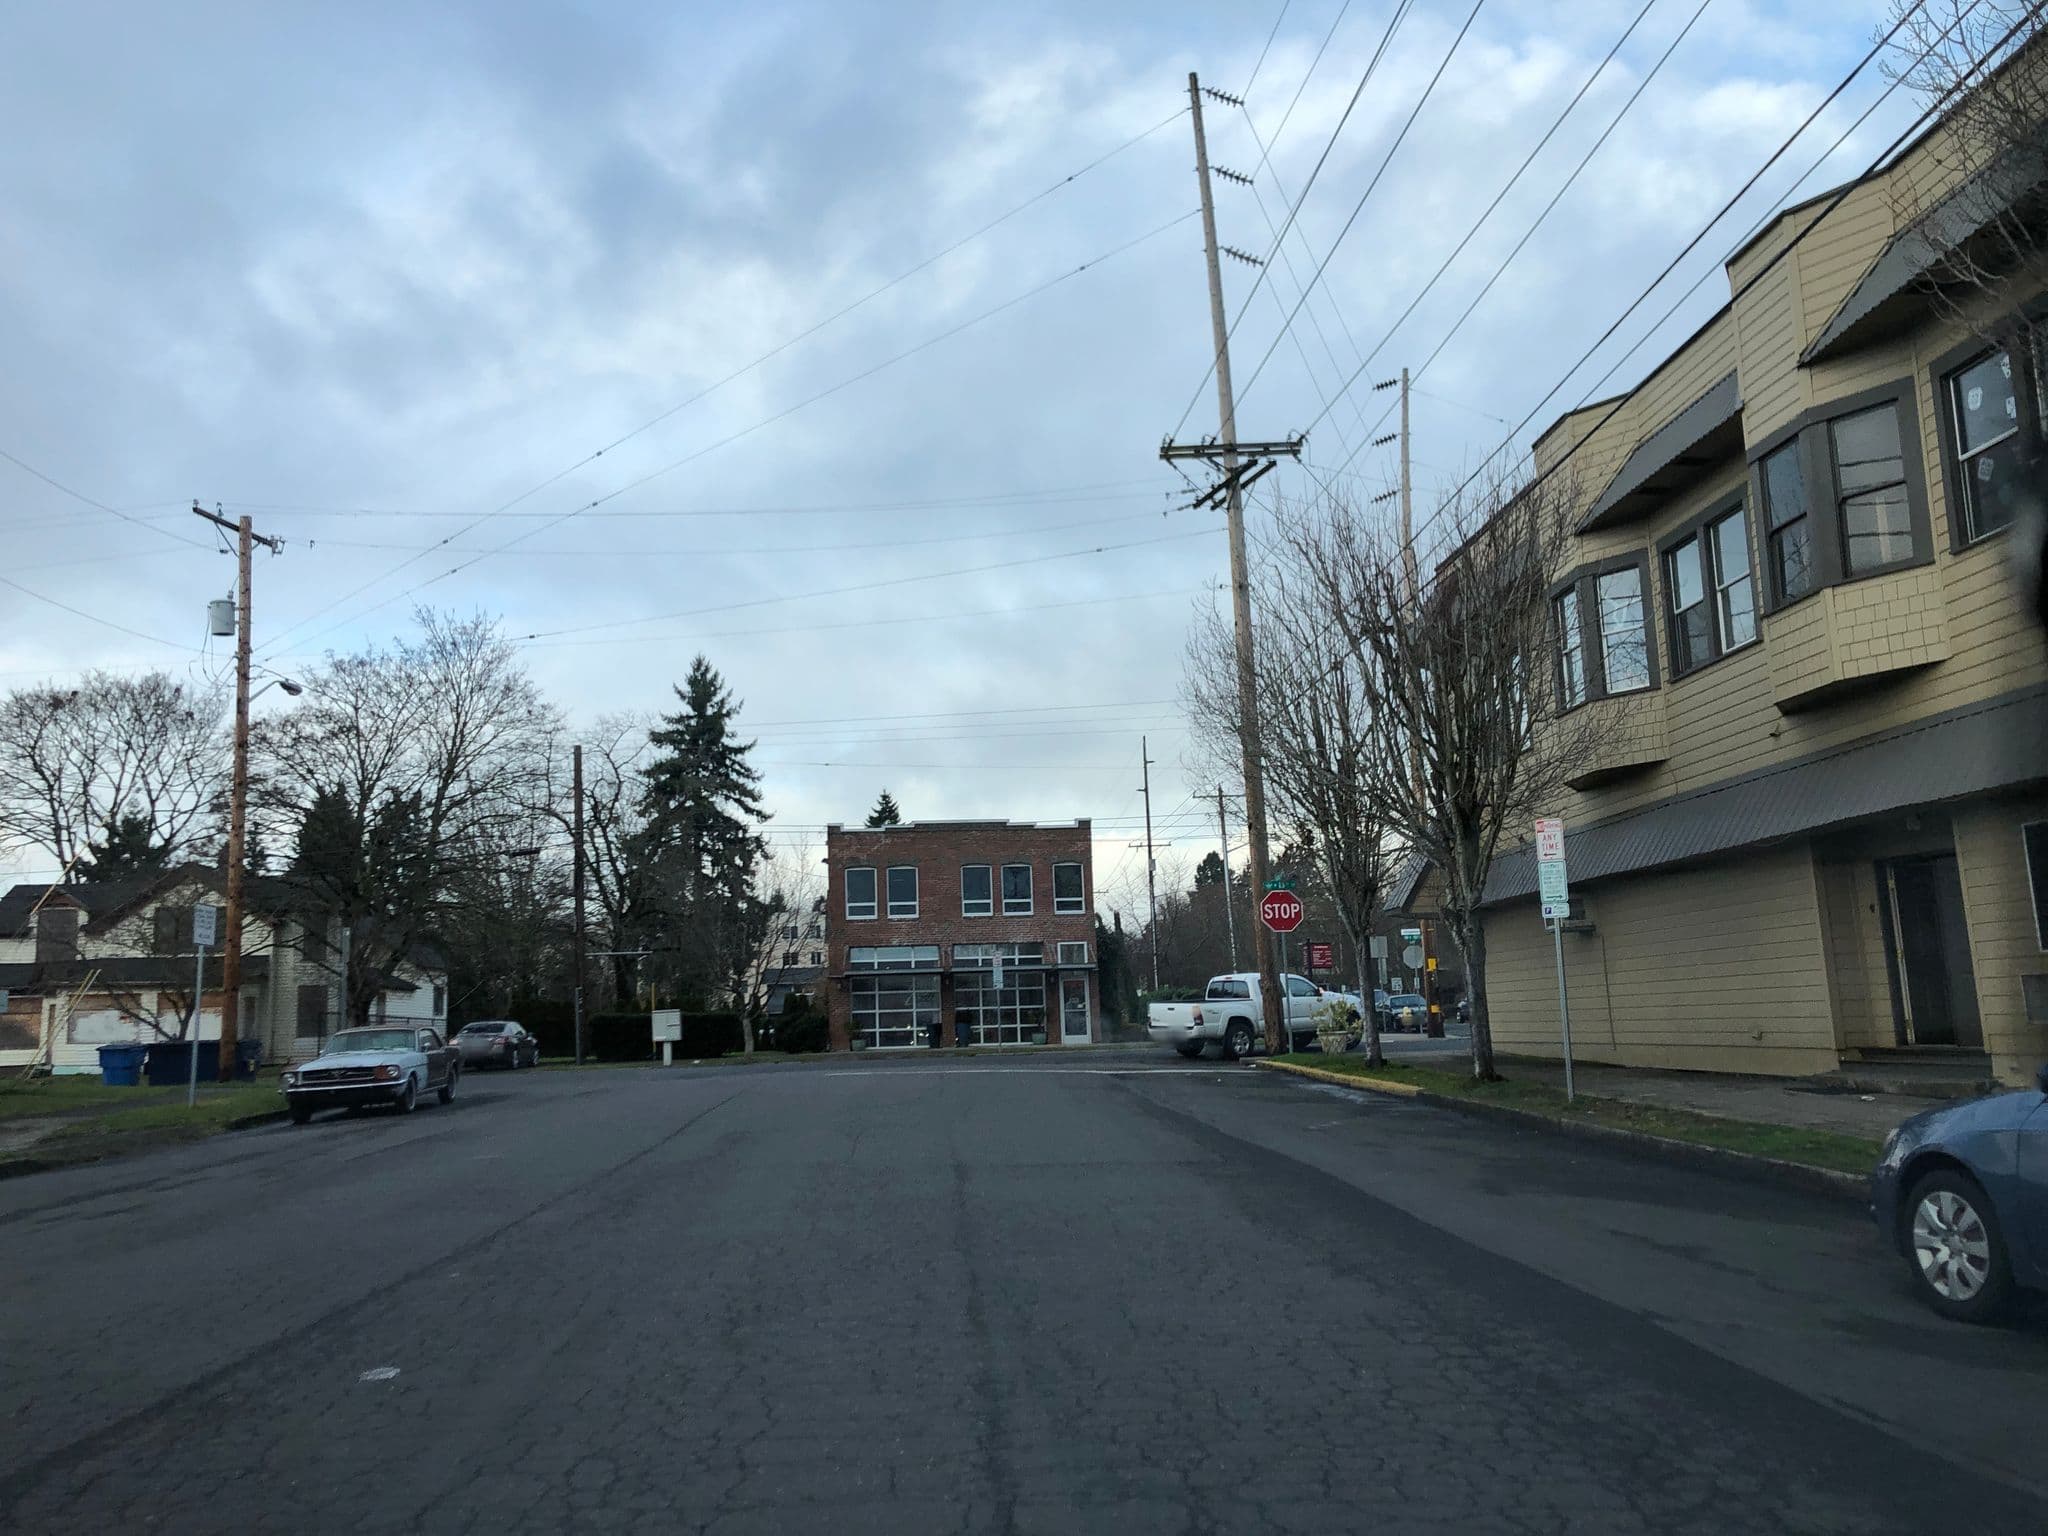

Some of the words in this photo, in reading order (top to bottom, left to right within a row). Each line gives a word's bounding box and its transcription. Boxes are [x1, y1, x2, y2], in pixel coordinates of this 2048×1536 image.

[1542, 833, 1558, 841] ANY
[1542, 842, 1561, 850] TIME
[1263, 903, 1300, 919] STOP
